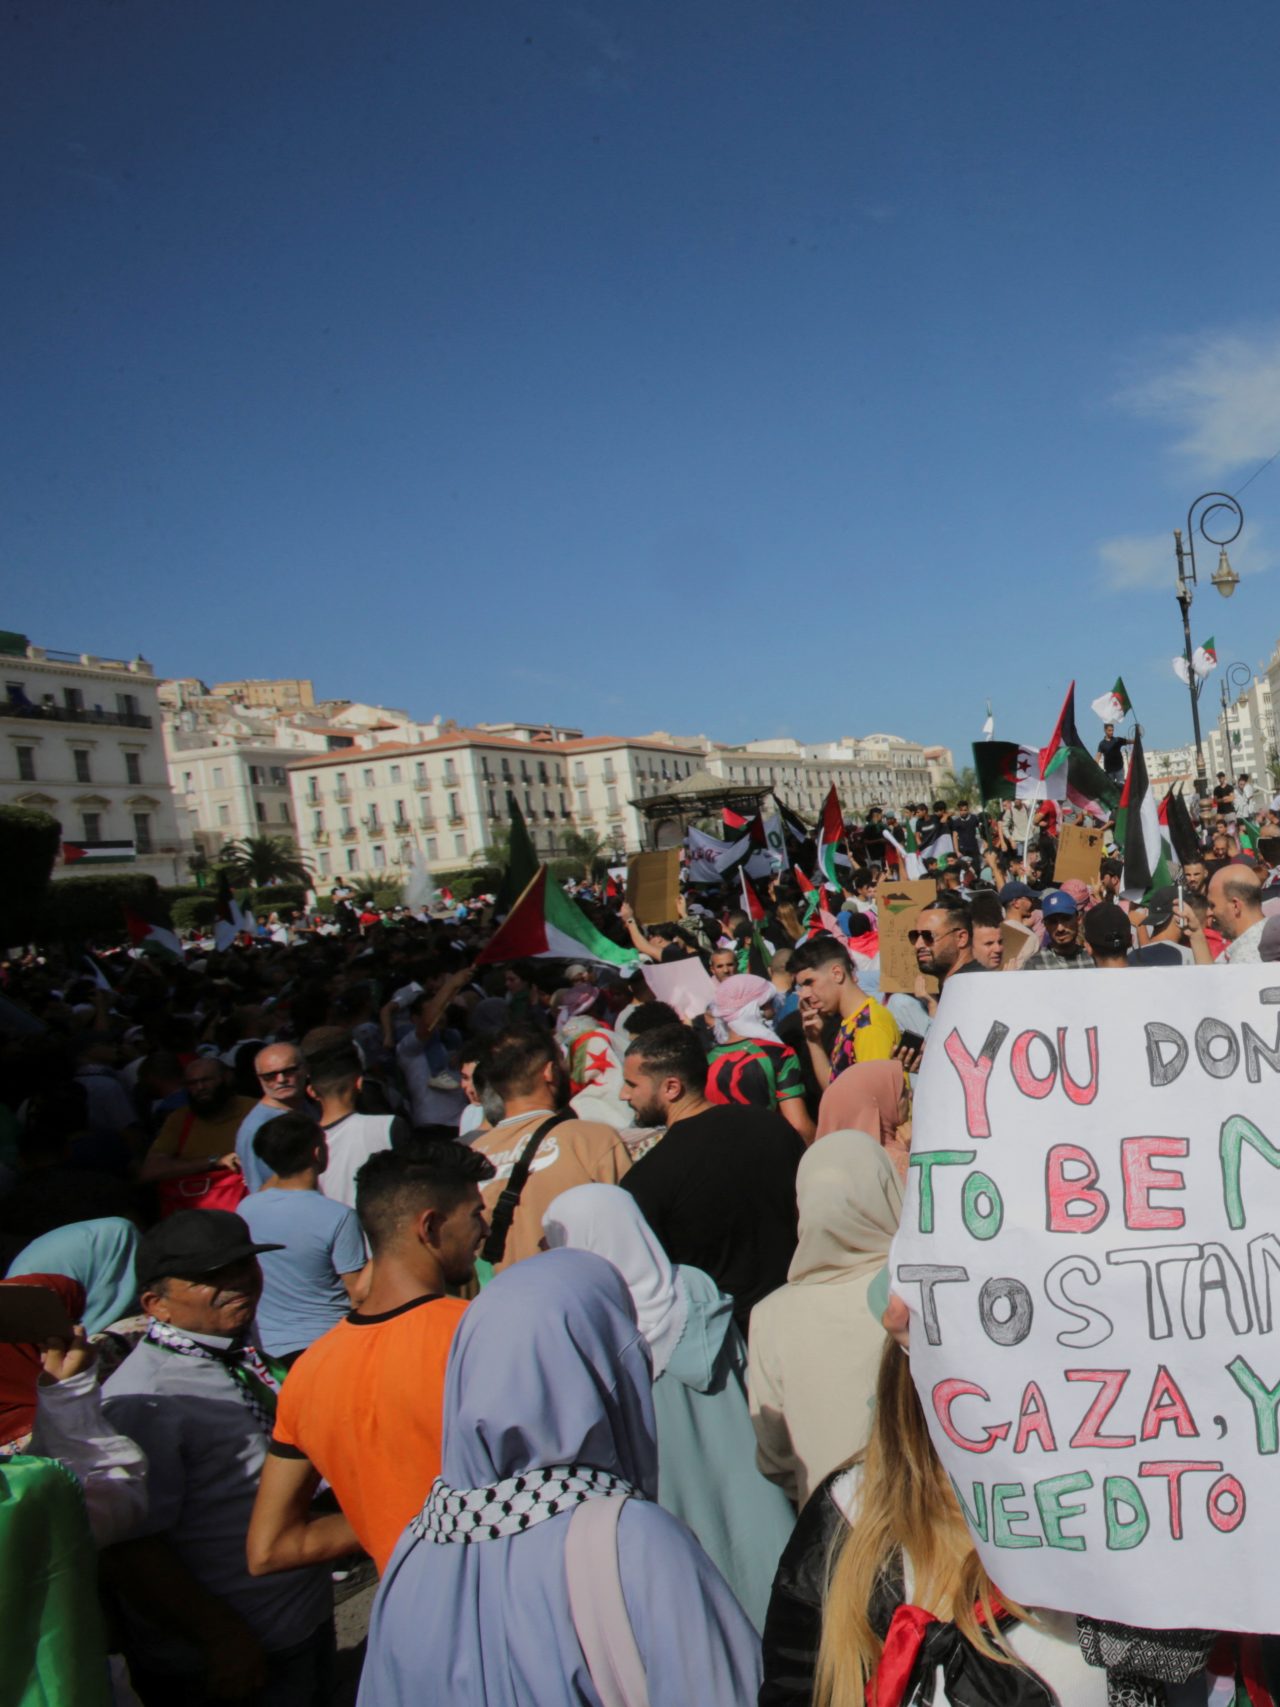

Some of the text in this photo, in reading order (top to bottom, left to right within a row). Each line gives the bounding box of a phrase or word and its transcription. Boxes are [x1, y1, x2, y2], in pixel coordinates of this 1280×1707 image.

[943, 1020, 1098, 1138] YOU
[909, 1149, 1004, 1241] TO
[1045, 1136, 1190, 1234] BE
[897, 1264, 1034, 1347] TO
[948, 1470, 1151, 1551] NEED
[1138, 1461, 1247, 1540] TO
